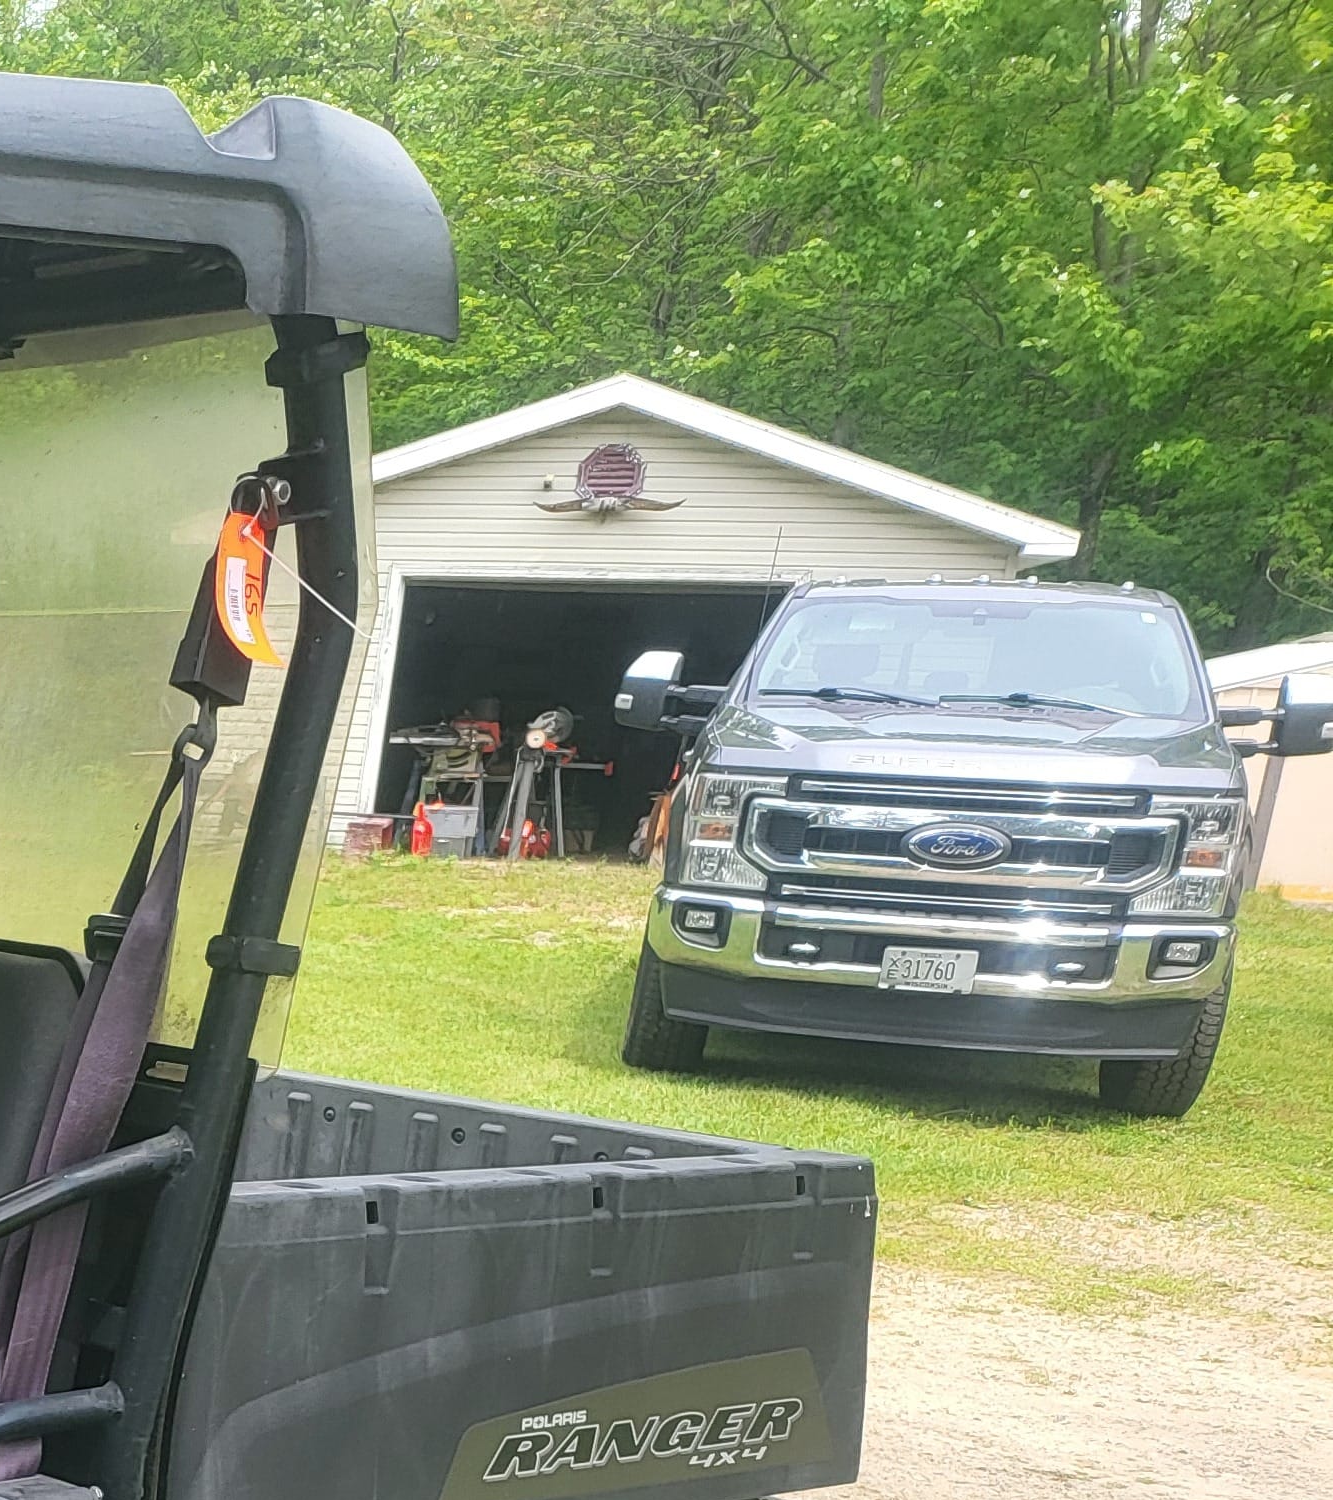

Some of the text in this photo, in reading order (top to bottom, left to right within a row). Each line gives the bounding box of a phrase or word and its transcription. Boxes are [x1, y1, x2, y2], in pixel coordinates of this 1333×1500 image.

[244, 572, 261, 617] 165
[929, 834, 981, 857] Ford
[901, 959, 956, 981] 31760
[522, 1409, 587, 1431] POLARIS
[482, 1397, 803, 1482] RANGER
